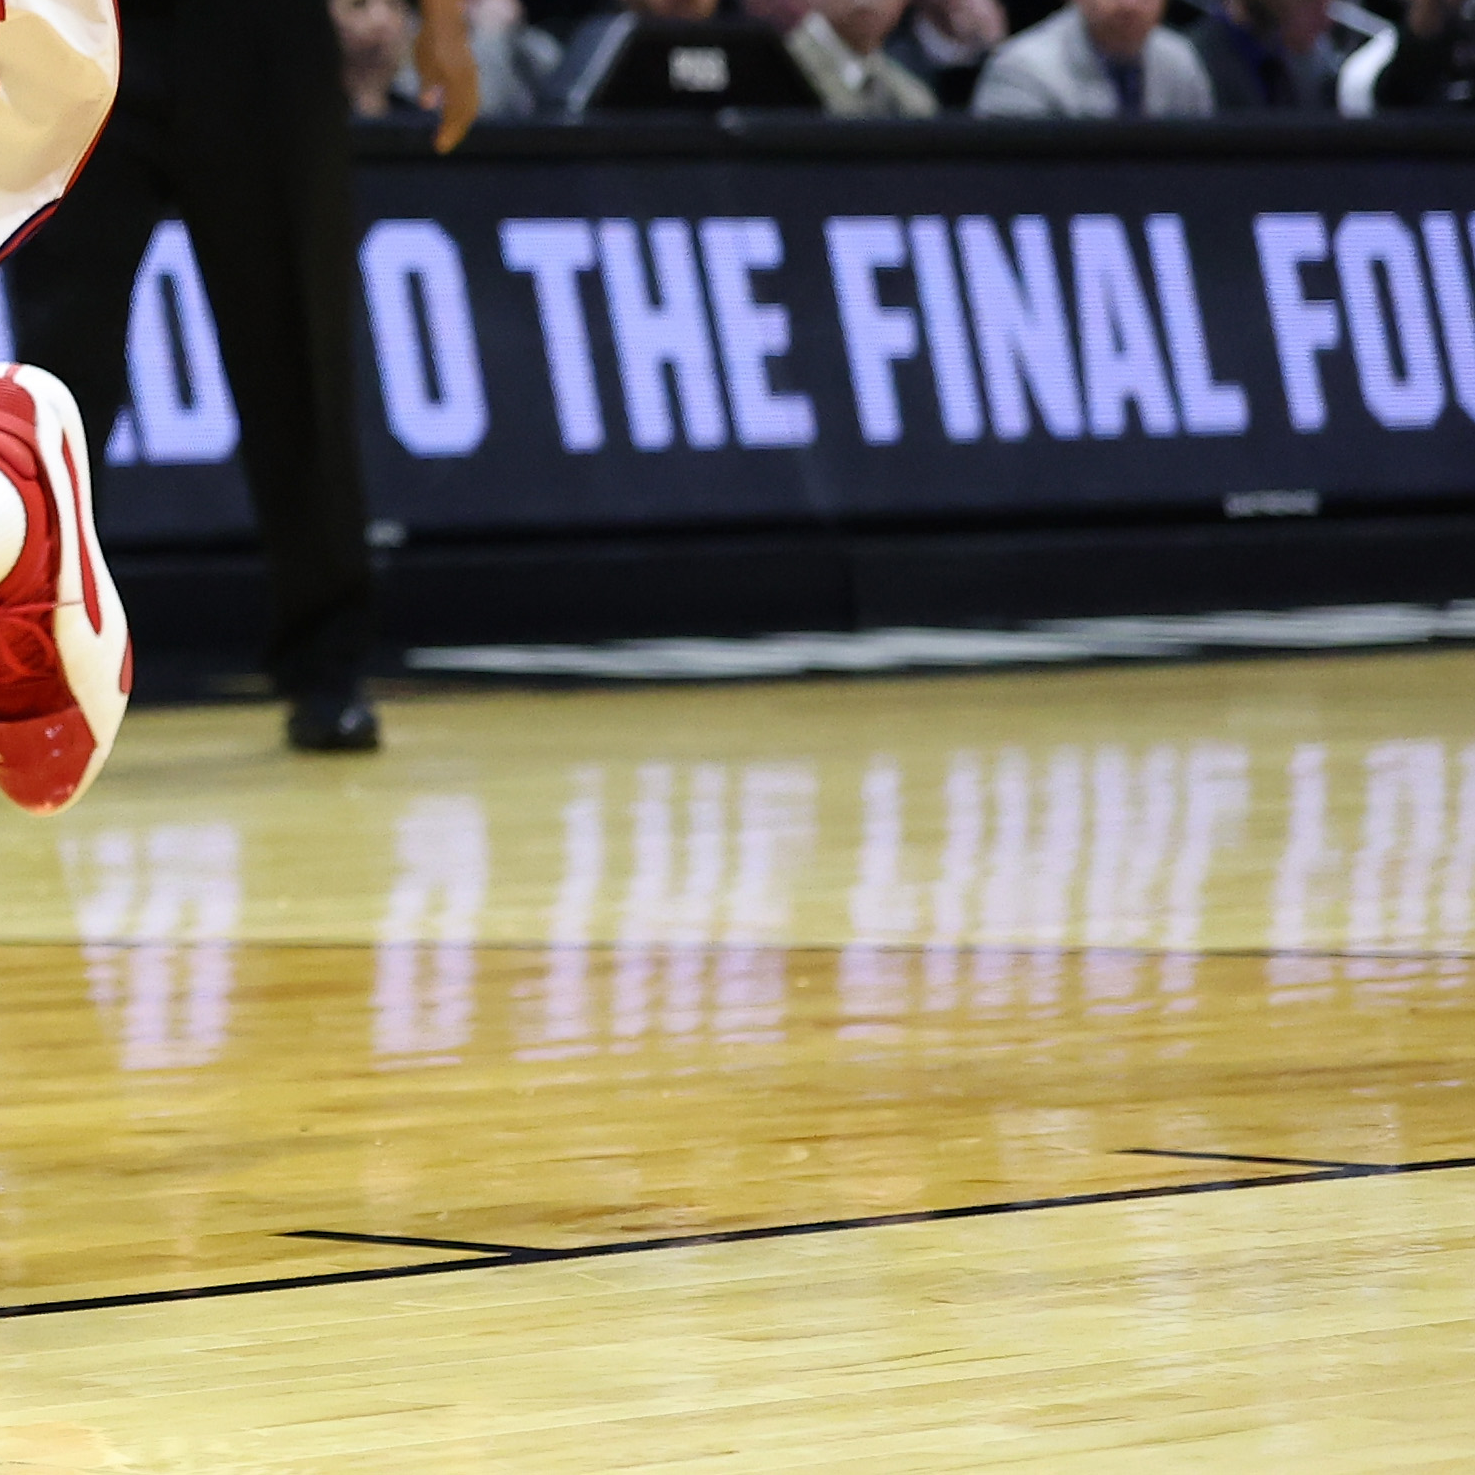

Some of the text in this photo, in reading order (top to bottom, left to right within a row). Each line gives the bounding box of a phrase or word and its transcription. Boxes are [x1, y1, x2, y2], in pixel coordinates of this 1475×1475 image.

[355, 218, 490, 459] O
[498, 216, 817, 451] THE
[824, 212, 1249, 445] FINAL
